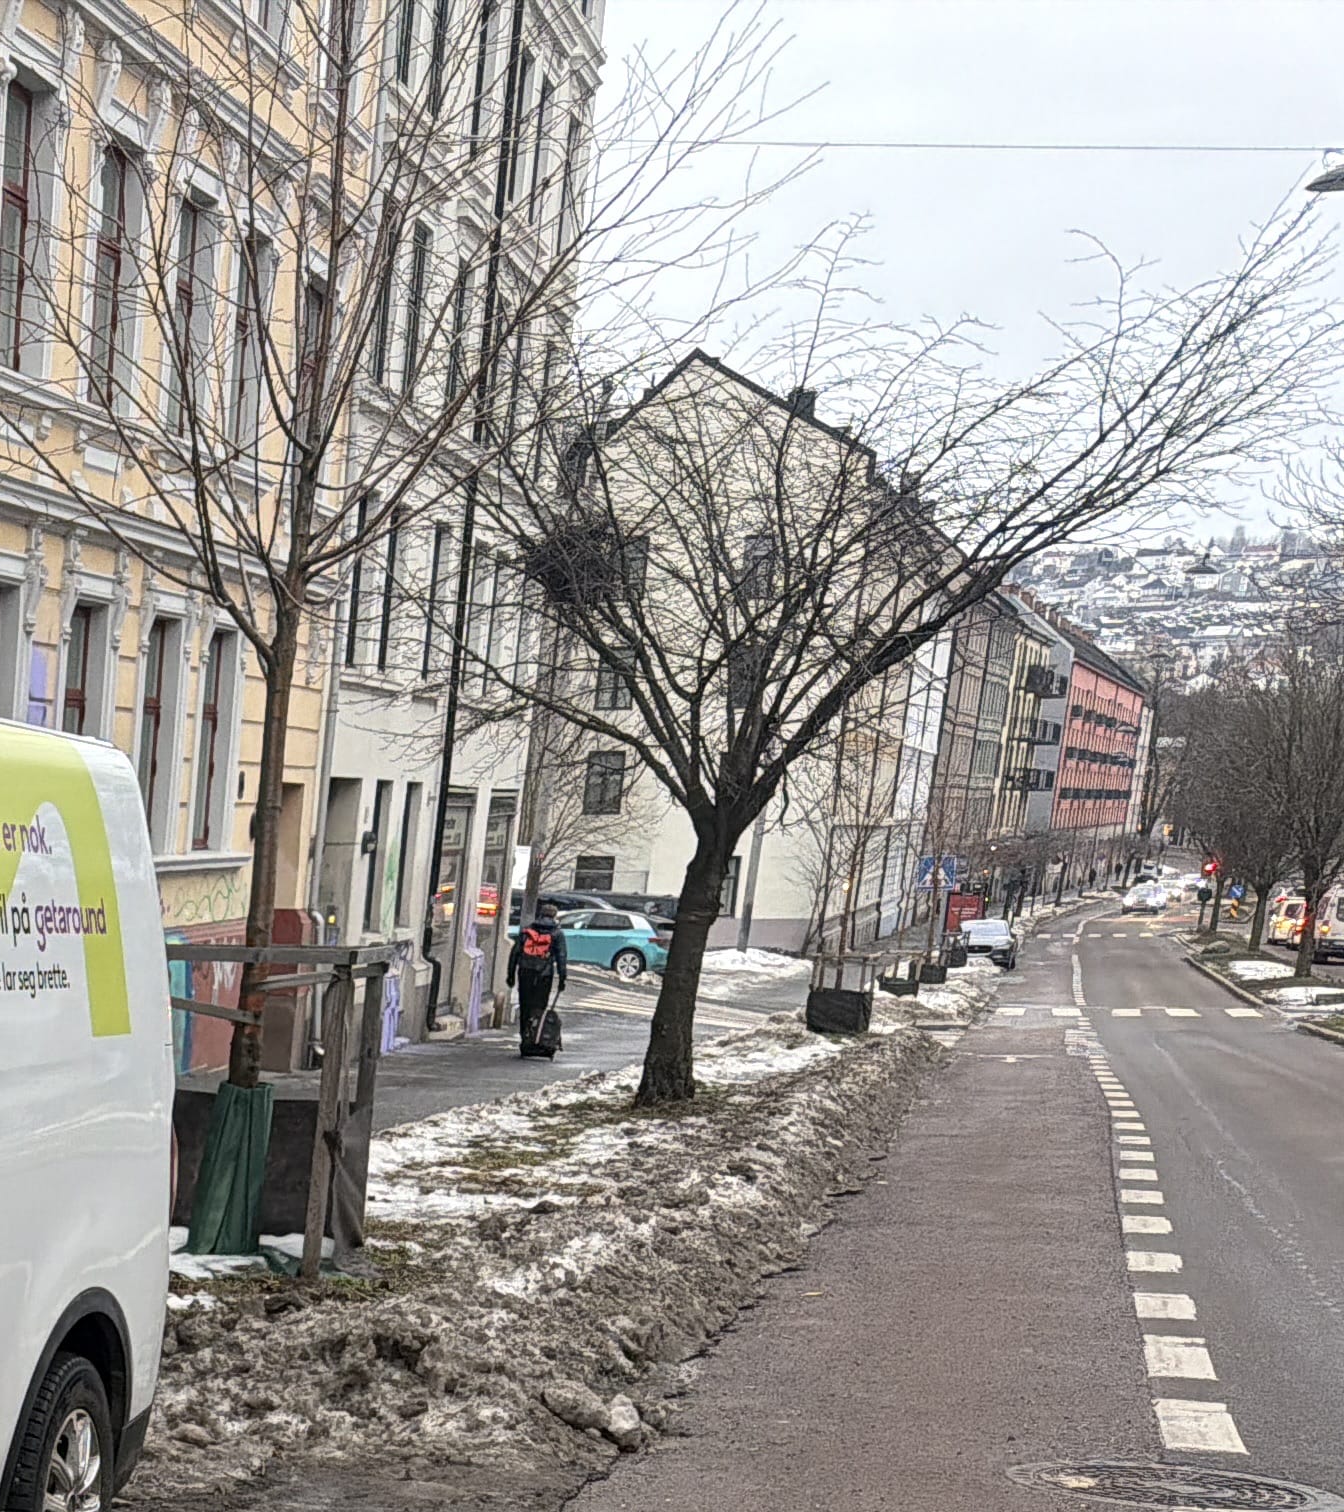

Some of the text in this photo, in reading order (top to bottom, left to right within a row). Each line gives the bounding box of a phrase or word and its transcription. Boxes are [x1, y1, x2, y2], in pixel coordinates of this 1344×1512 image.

[2, 821, 17, 851] er
[19, 814, 53, 854] nok.
[11, 892, 31, 947] på
[35, 898, 107, 952] getaround
[2, 961, 16, 991] lar
[18, 969, 36, 998] seg
[36, 961, 70, 990] brette.
